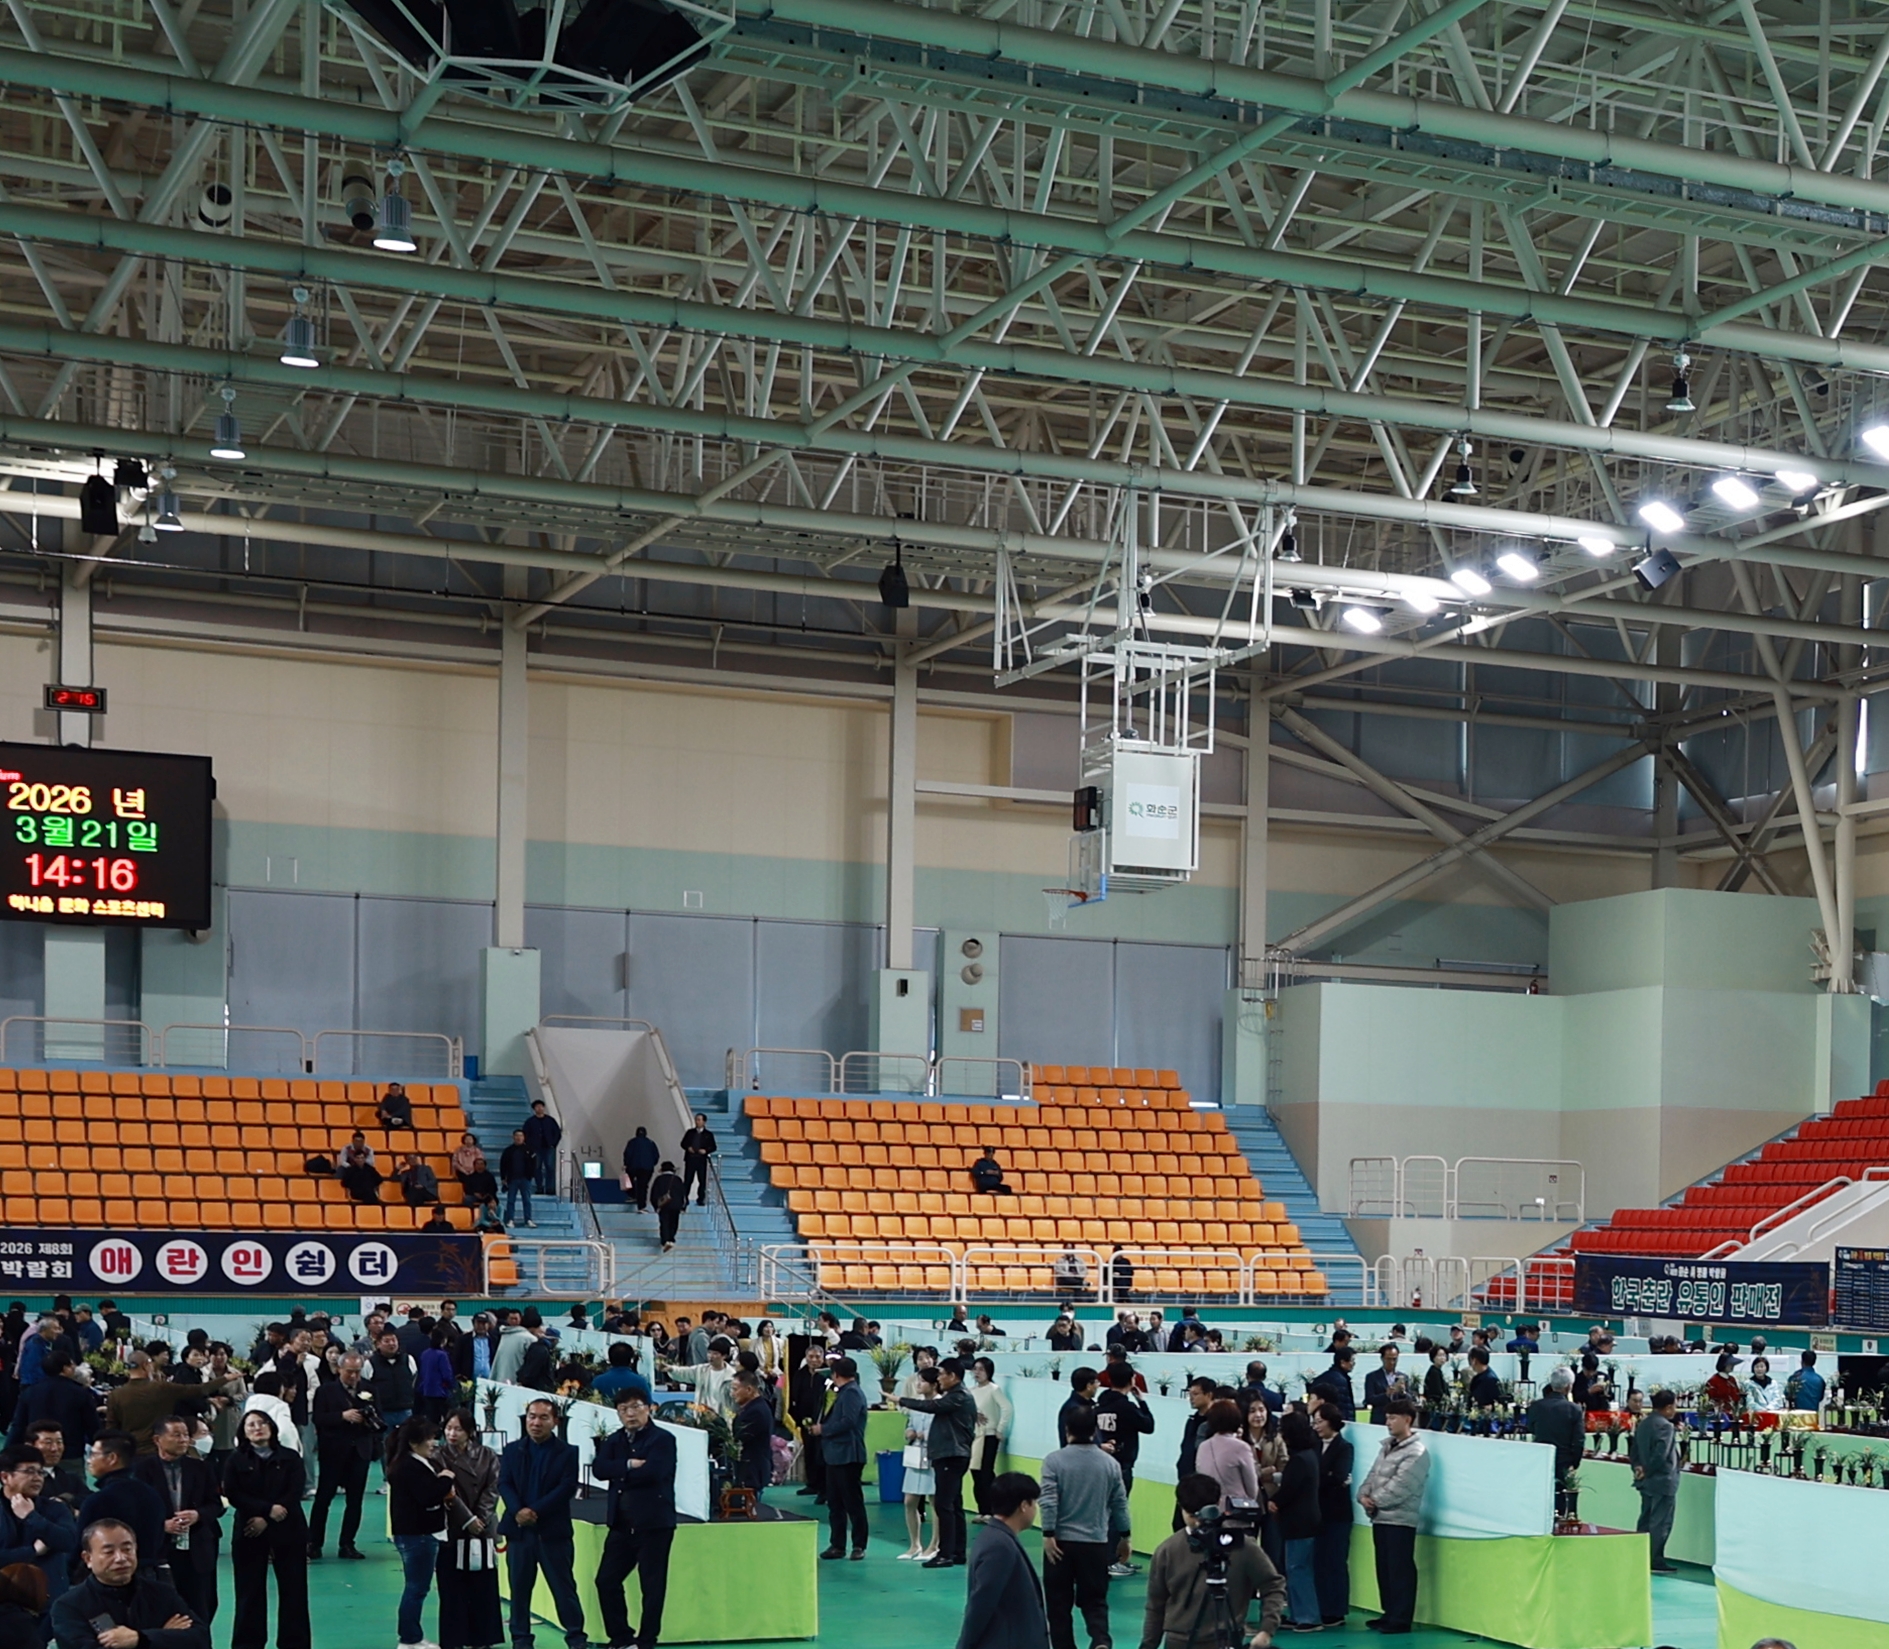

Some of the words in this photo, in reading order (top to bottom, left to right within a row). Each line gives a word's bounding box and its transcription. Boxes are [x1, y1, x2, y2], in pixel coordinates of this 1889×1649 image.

[8, 782, 92, 814] 2026
[113, 788, 146, 818] 년
[25, 853, 138, 892] 14:16
[58, 897, 90, 914] 문화
[92, 899, 165, 918] 스포츠센터
[0, 1242, 33, 1255] 2026
[38, 1242, 73, 1256] 제8회
[0, 1260, 73, 1279] 박람회
[1611, 1275, 1673, 1314] 한국춘란
[1676, 1280, 1726, 1316] 유통인
[1730, 1282, 1782, 1318] 판매전
